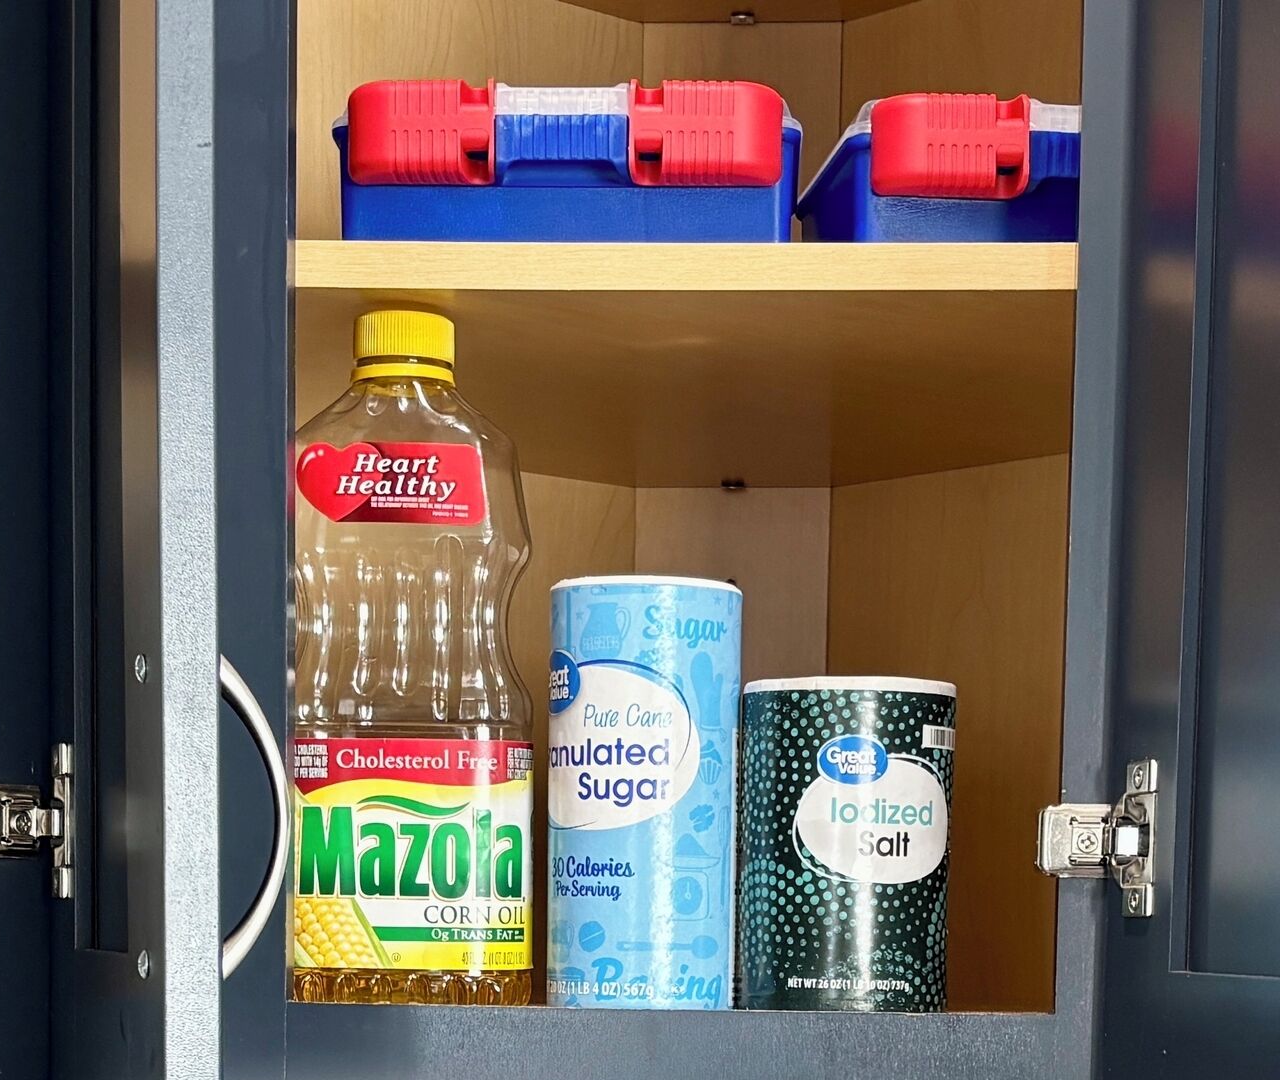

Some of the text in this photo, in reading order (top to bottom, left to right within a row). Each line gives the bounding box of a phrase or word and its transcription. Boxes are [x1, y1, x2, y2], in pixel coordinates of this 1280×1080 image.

[353, 453, 439, 474] Heart
[336, 475, 456, 501] Healthy
[583, 703, 673, 728] Pure Cane
[336, 748, 450, 770] Cholesterol
[457, 750, 498, 770] Free
[826, 745, 877, 764] Great
[838, 761, 877, 775] Value
[578, 772, 670, 807] Sugar
[830, 797, 933, 826] Iodized
[298, 806, 524, 899] Mazola
[858, 830, 910, 857] Salt
[566, 855, 636, 878] Calories
[555, 879, 622, 901] Per Serving
[423, 905, 526, 925] CORN OIL
[451, 928, 493, 940] TRANS
[496, 929, 514, 940] FAT
[577, 982, 590, 995] LB
[592, 982, 600, 995] 4
[602, 982, 621, 998] OZ)
[787, 978, 803, 988] NET
[803, 978, 817, 989] WT
[818, 979, 829, 989] 26
[830, 979, 841, 989] OZ
[891, 981, 910, 993] 737g
